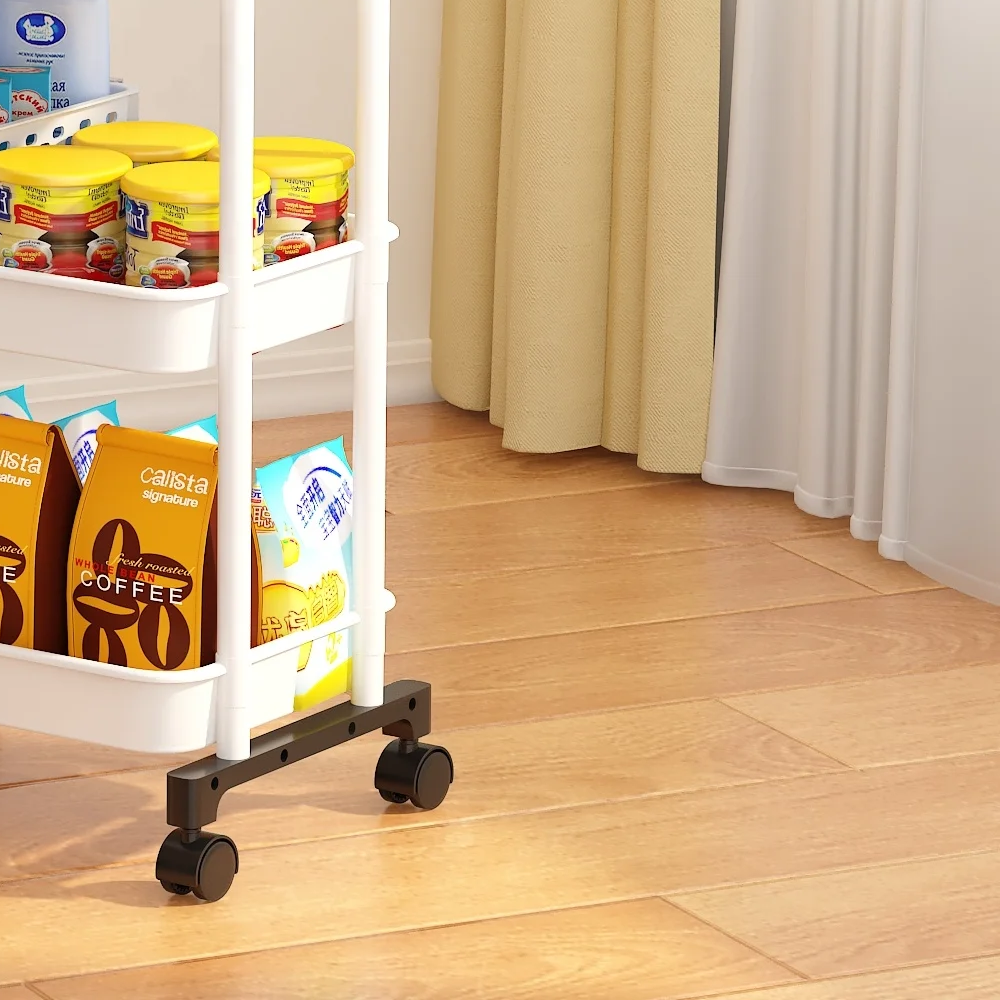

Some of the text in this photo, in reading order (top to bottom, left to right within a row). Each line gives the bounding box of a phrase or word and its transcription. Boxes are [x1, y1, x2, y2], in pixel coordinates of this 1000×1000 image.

[51, 81, 66, 92] ая
[12, 93, 46, 113] тский
[140, 467, 209, 495] Calista
[142, 489, 198, 508] signature
[75, 558, 156, 583] WHOLE BEAN
[106, 552, 195, 577] fresh roasted
[80, 570, 183, 605] COFFEE
